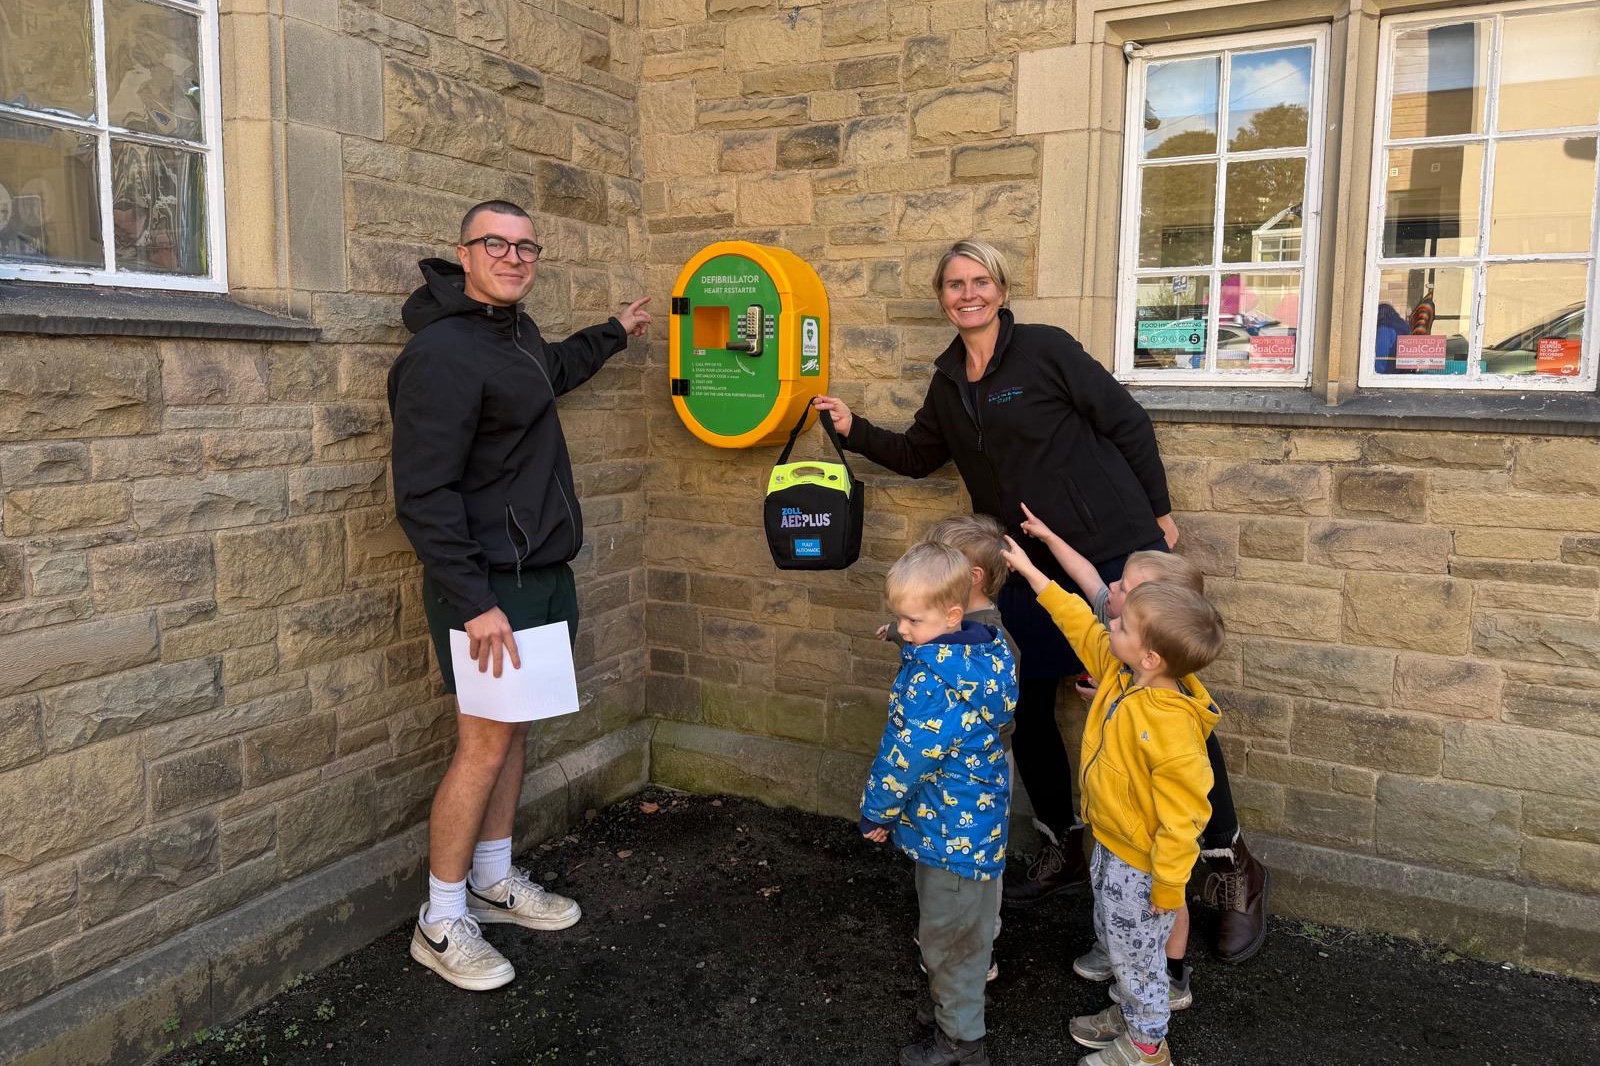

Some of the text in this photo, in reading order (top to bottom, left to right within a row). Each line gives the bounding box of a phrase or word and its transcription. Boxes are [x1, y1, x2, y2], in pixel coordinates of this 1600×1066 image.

[701, 275, 759, 284] DEFIBRILLATOR
[1191, 335, 1198, 344] 5
[1398, 344, 1445, 354] DualCom
